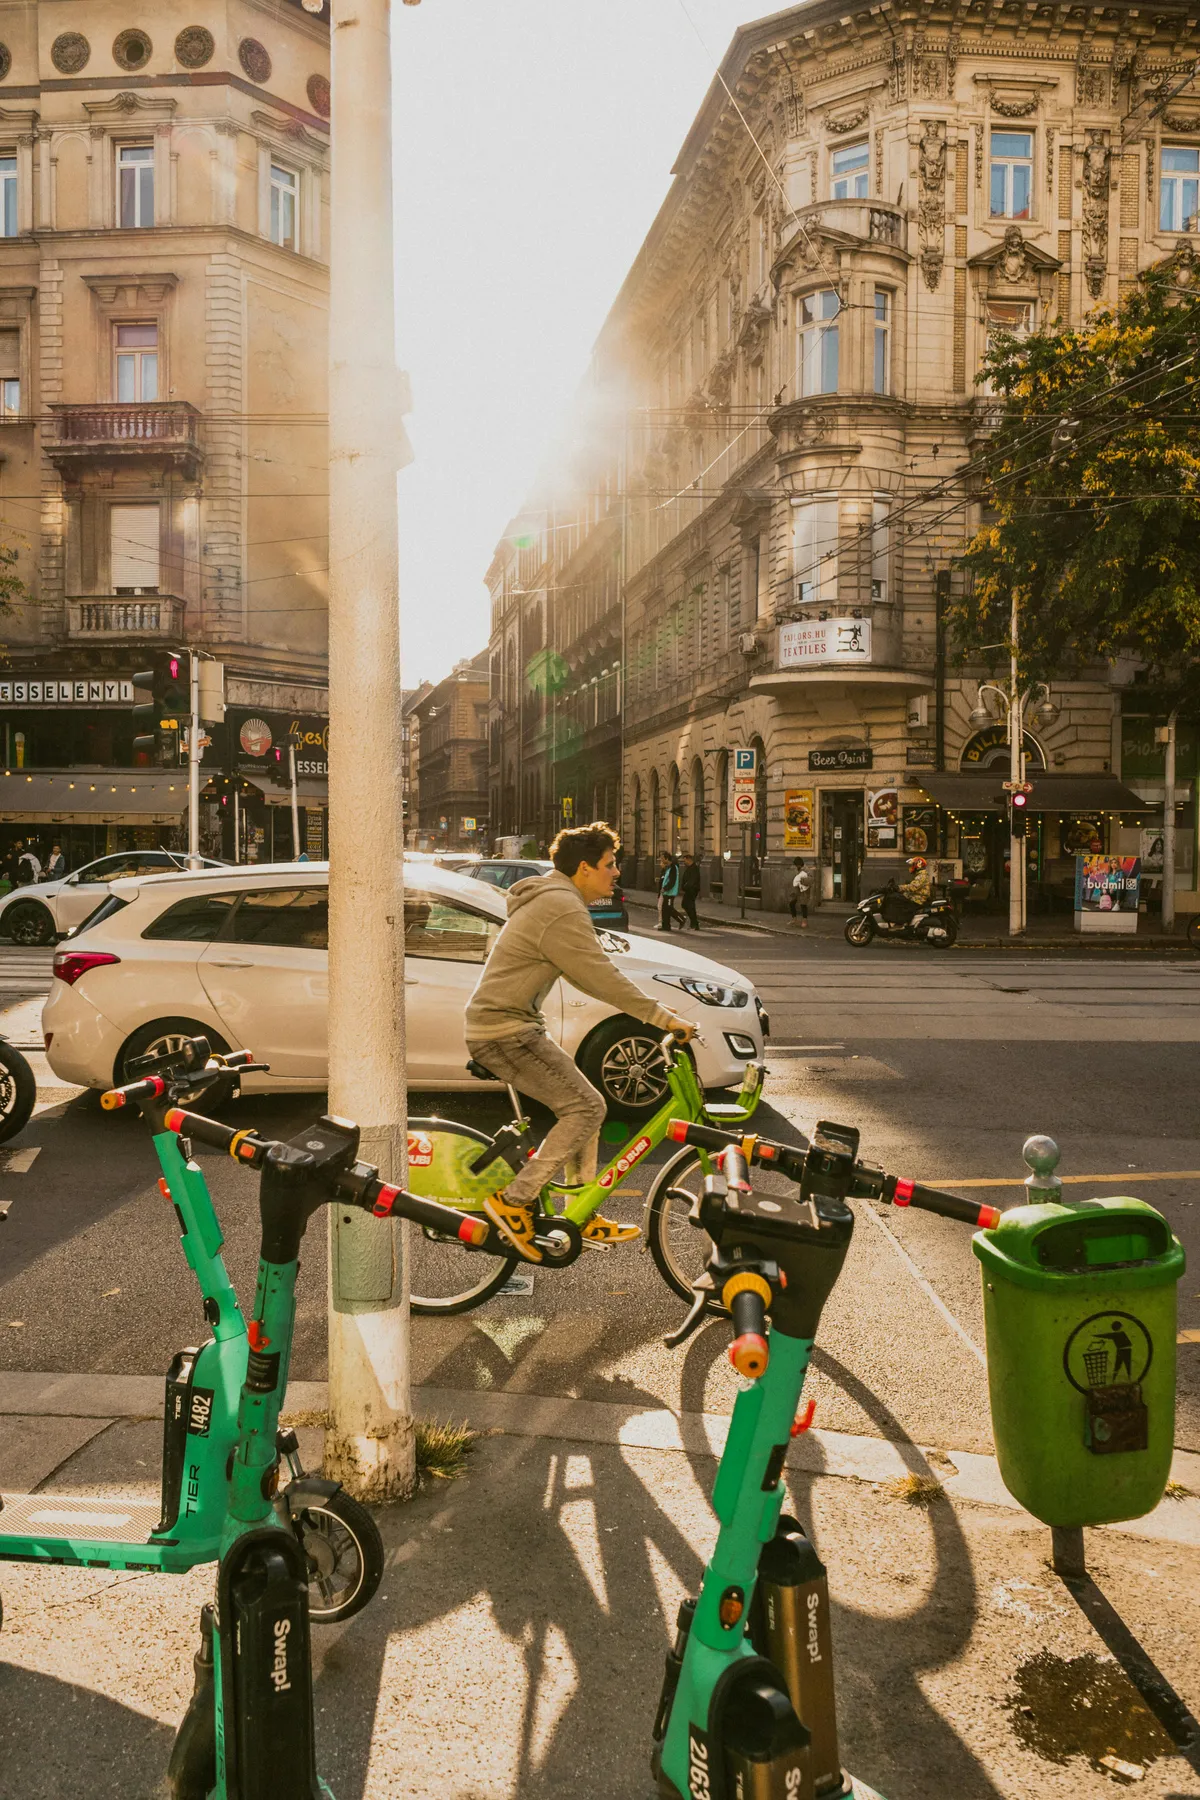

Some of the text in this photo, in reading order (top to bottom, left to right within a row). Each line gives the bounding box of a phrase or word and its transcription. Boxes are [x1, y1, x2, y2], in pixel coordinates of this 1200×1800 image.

[784, 630, 826, 642] TAILORS.HU
[784, 644, 826, 657] TEXTILES
[740, 753, 751, 767] P
[811, 751, 869, 766] Beer Point
[1087, 878, 1125, 890] budmil
[626, 1139, 649, 1163] BUBI
[174, 1395, 182, 1420] TIER
[185, 1464, 201, 1518] TIER
[806, 1592, 822, 1663] Swap!
[270, 1618, 291, 1692] Swap!
